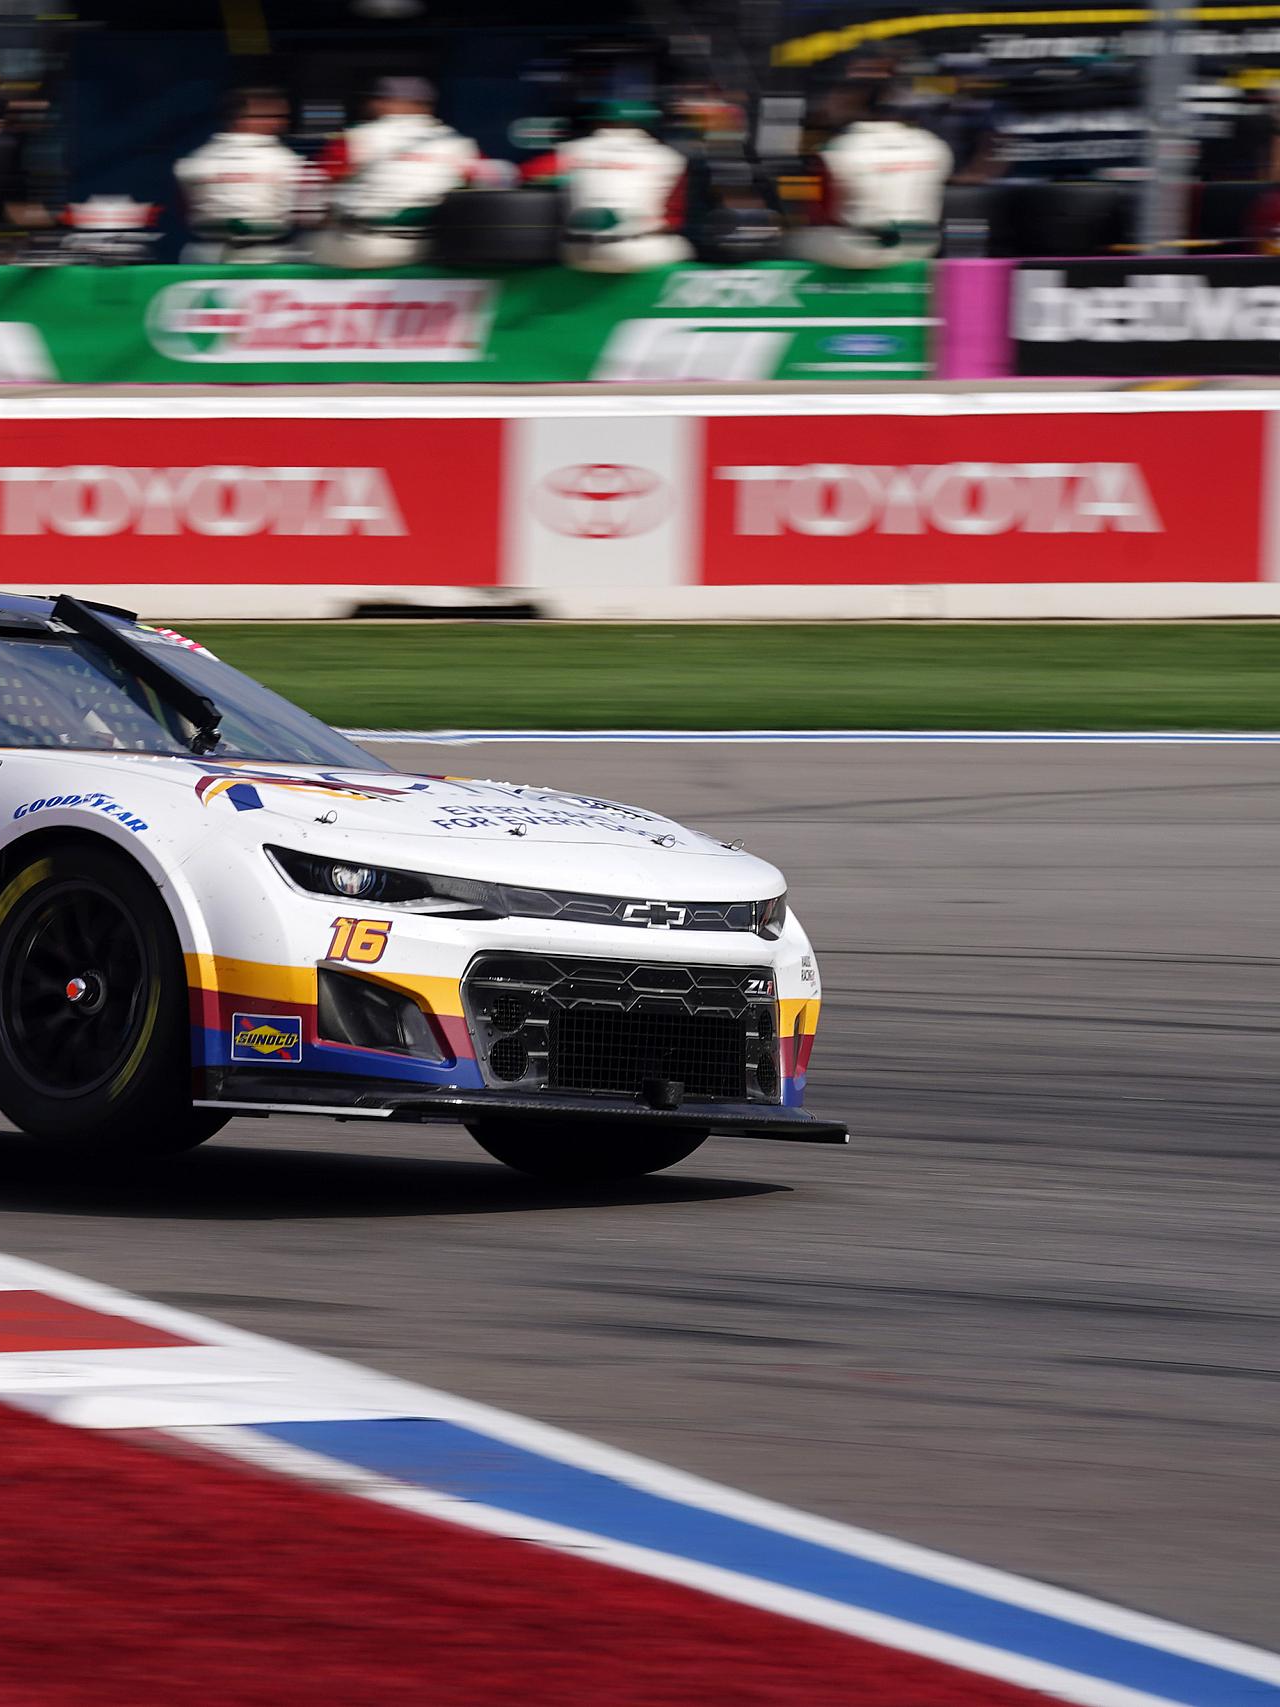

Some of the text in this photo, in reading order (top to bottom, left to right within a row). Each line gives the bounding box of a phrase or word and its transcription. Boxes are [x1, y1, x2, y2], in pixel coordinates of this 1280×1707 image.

[714, 461, 1164, 536] TOYOTA
[12, 792, 149, 834] GOODYEAR
[431, 816, 500, 830] FOR
[496, 815, 594, 829] EVERY
[437, 804, 537, 816] EVERY
[326, 915, 393, 964] 16
[236, 1032, 299, 1048] SUNOCO
